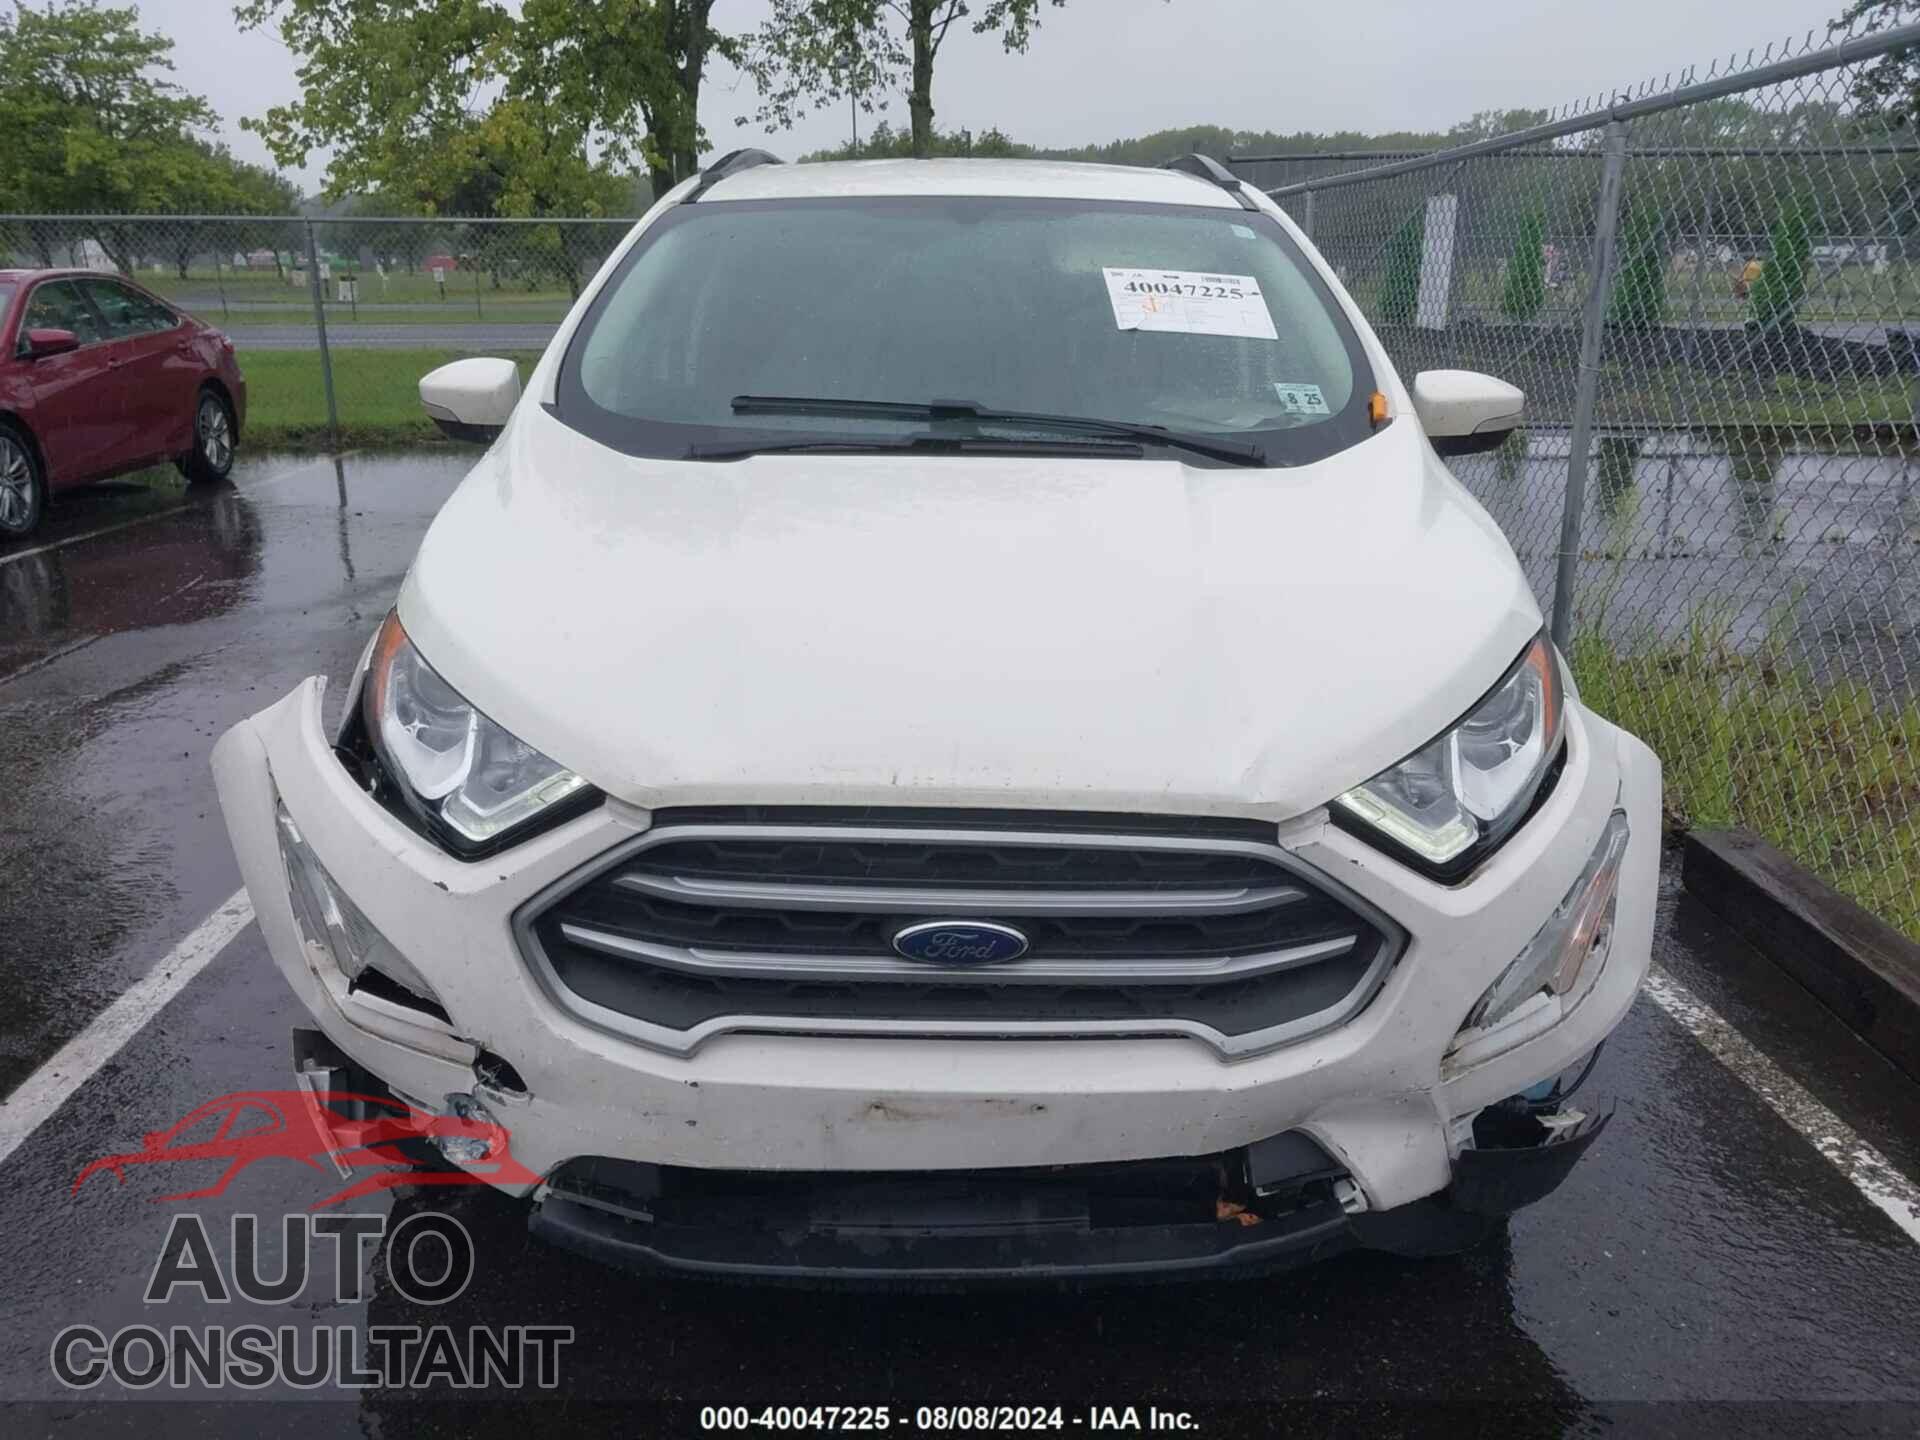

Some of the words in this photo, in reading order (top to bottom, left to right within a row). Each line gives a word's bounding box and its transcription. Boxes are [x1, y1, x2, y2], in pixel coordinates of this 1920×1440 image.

[1123, 281, 1244, 299] 40047225
[1287, 392, 1298, 405] 8
[1304, 393, 1321, 405] 25
[924, 932, 997, 959] Ford
